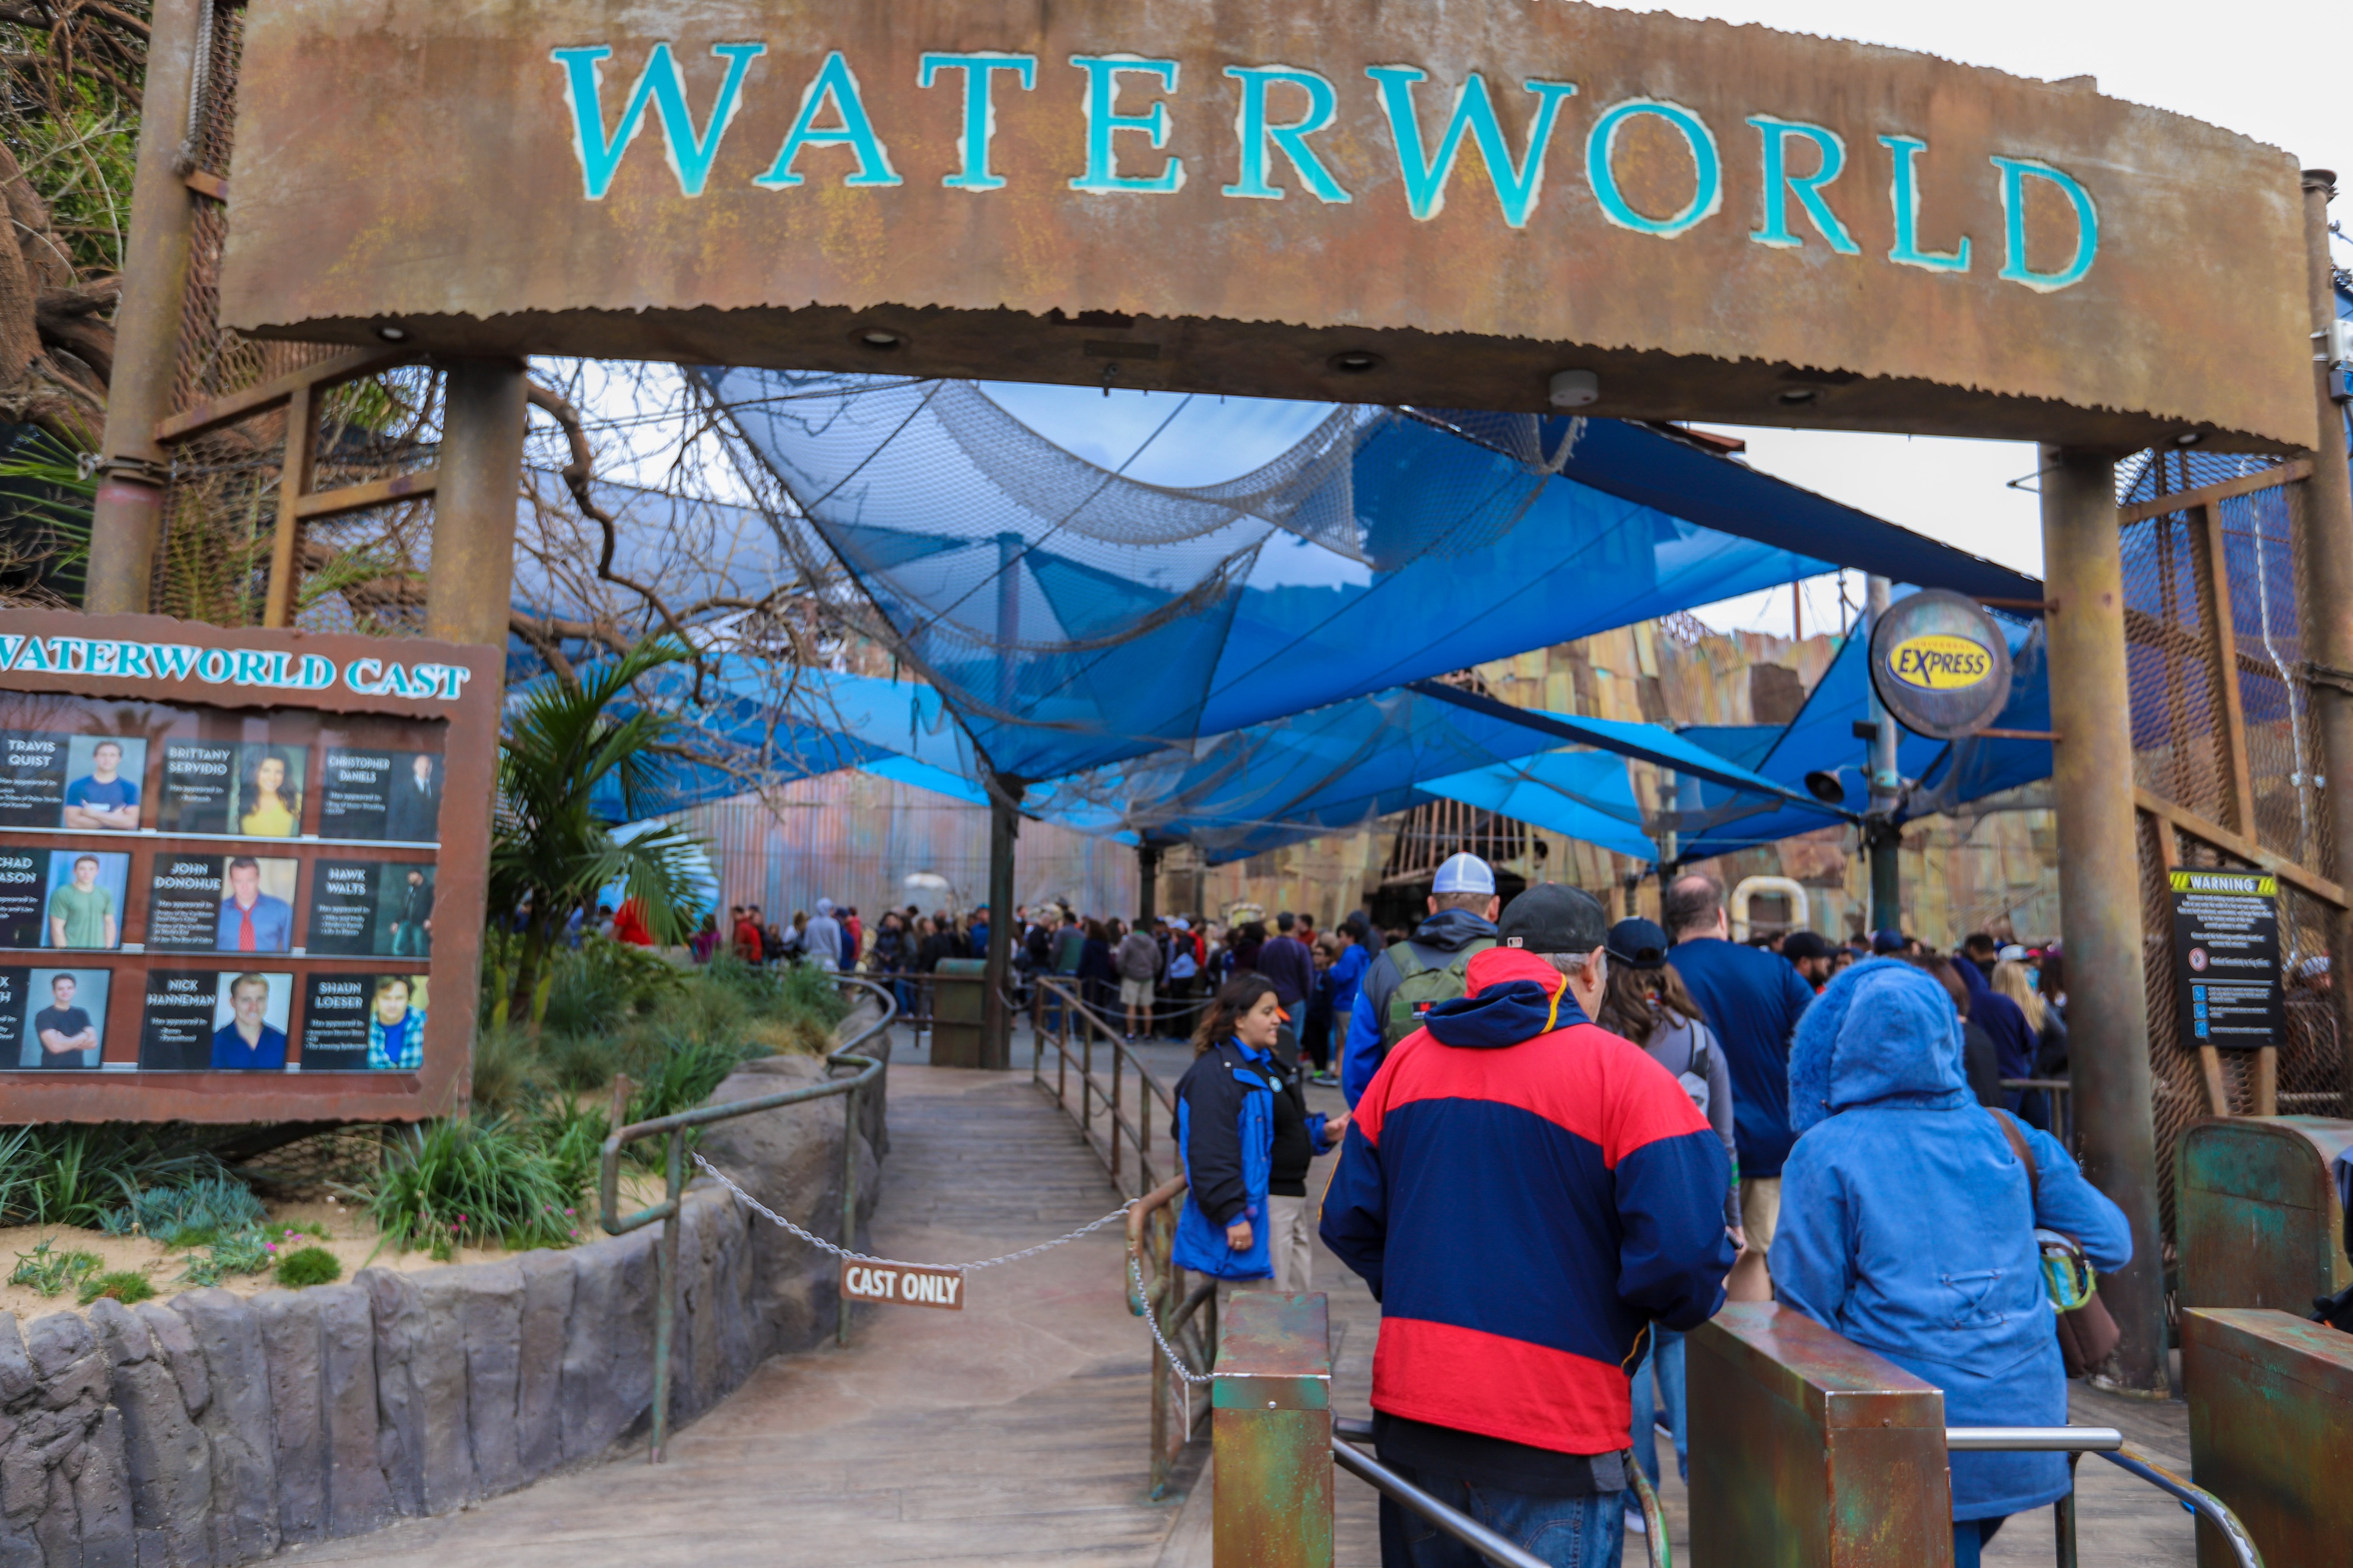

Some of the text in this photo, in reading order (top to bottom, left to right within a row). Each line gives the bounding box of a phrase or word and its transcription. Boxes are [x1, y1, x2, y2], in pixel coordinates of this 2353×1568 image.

[551, 43, 2101, 292] WATERWORLD
[1900, 649, 1985, 684] EXPRESS
[344, 657, 471, 700] CAST
[8, 739, 56, 753] TRAVIS
[8, 753, 52, 767] QUIST
[168, 746, 231, 761] BRITTANY
[168, 761, 228, 776] SERVIDIO
[328, 755, 390, 771] CHRISTOPHER
[338, 769, 377, 783] DANIELS
[170, 862, 208, 876] JOHN
[328, 868, 366, 882] HAWK
[154, 876, 221, 890] DONOHUE
[326, 882, 366, 896] WALTS
[2190, 874, 2257, 892] WARNING
[167, 979, 198, 992] NICK
[319, 982, 361, 994] SHAUN
[147, 993, 215, 1007] HANNEMAN
[315, 996, 363, 1009] LOESER
[846, 1267, 961, 1305] CAST ONLY
